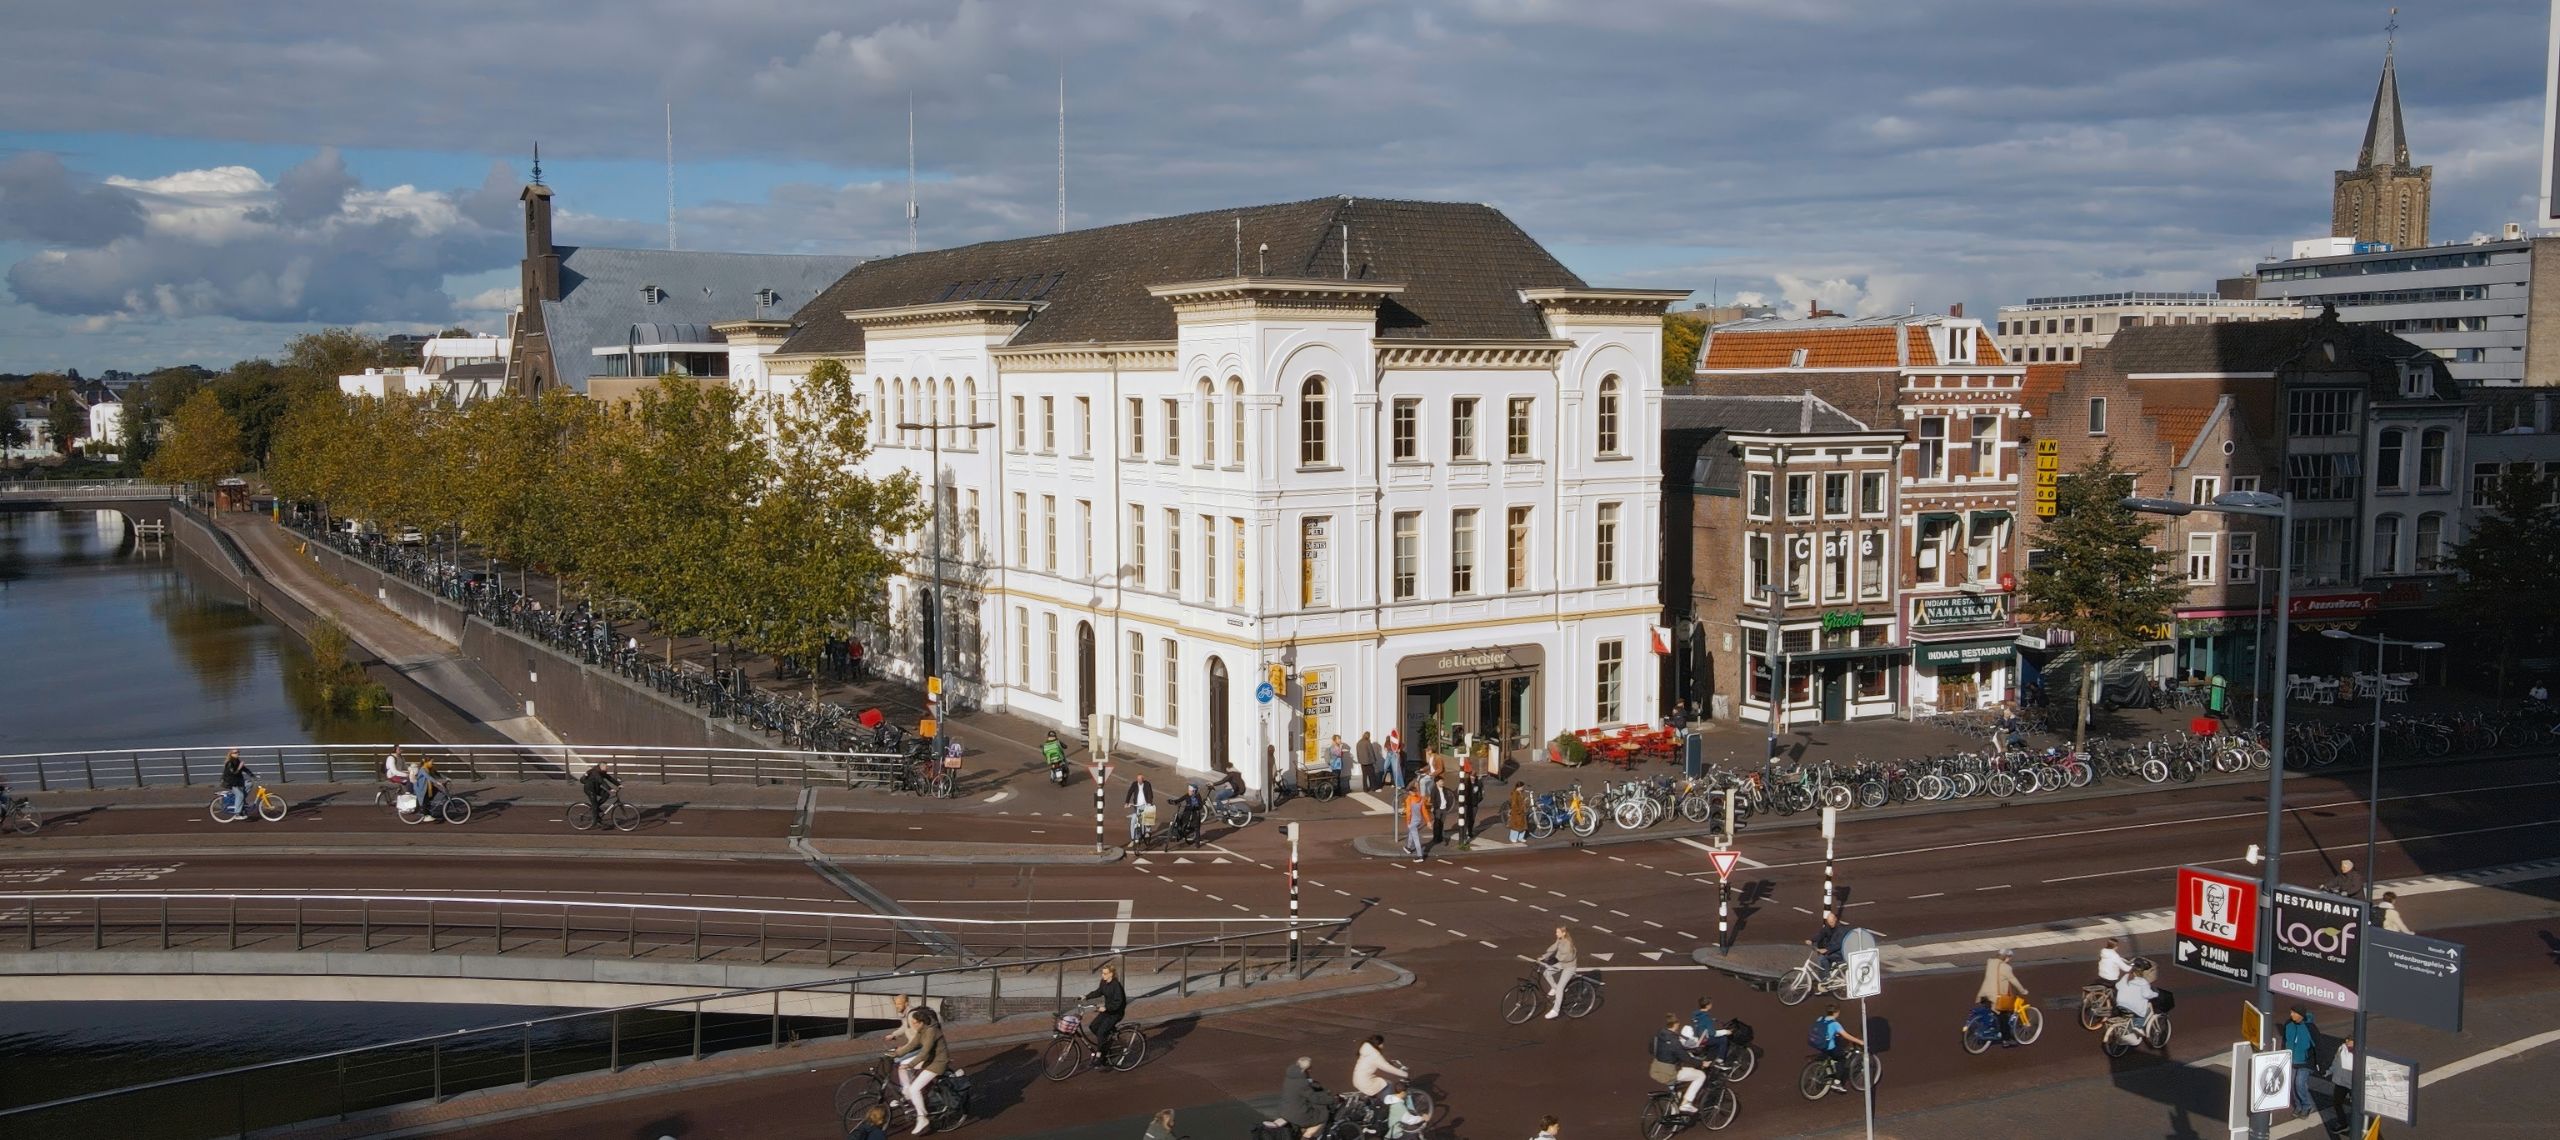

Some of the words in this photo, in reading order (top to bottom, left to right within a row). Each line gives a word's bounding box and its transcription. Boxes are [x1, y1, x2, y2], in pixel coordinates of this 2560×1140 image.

[1795, 535, 1873, 559] Café
[1951, 597, 1997, 606] RESTAANT
[1927, 605, 1992, 617] NAMASKAR
[1438, 657, 1452, 669] de
[1453, 652, 1506, 667] Utrechter
[1927, 650, 1959, 660] INDIAAS
[1961, 646, 2012, 657] RESTAURANT
[2275, 892, 2359, 918] RESTAURANT
[2199, 919, 2230, 936] KFC
[2200, 944, 2208, 957] 3
[2209, 947, 2230, 963] MIN
[2278, 943, 2297, 954] lunch
[2200, 958, 2239, 977] Vredenburg
[2388, 951, 2445, 969] Vredenburgplein
[2281, 978, 2334, 1000] Domplein
[2337, 991, 2346, 1002] 8
